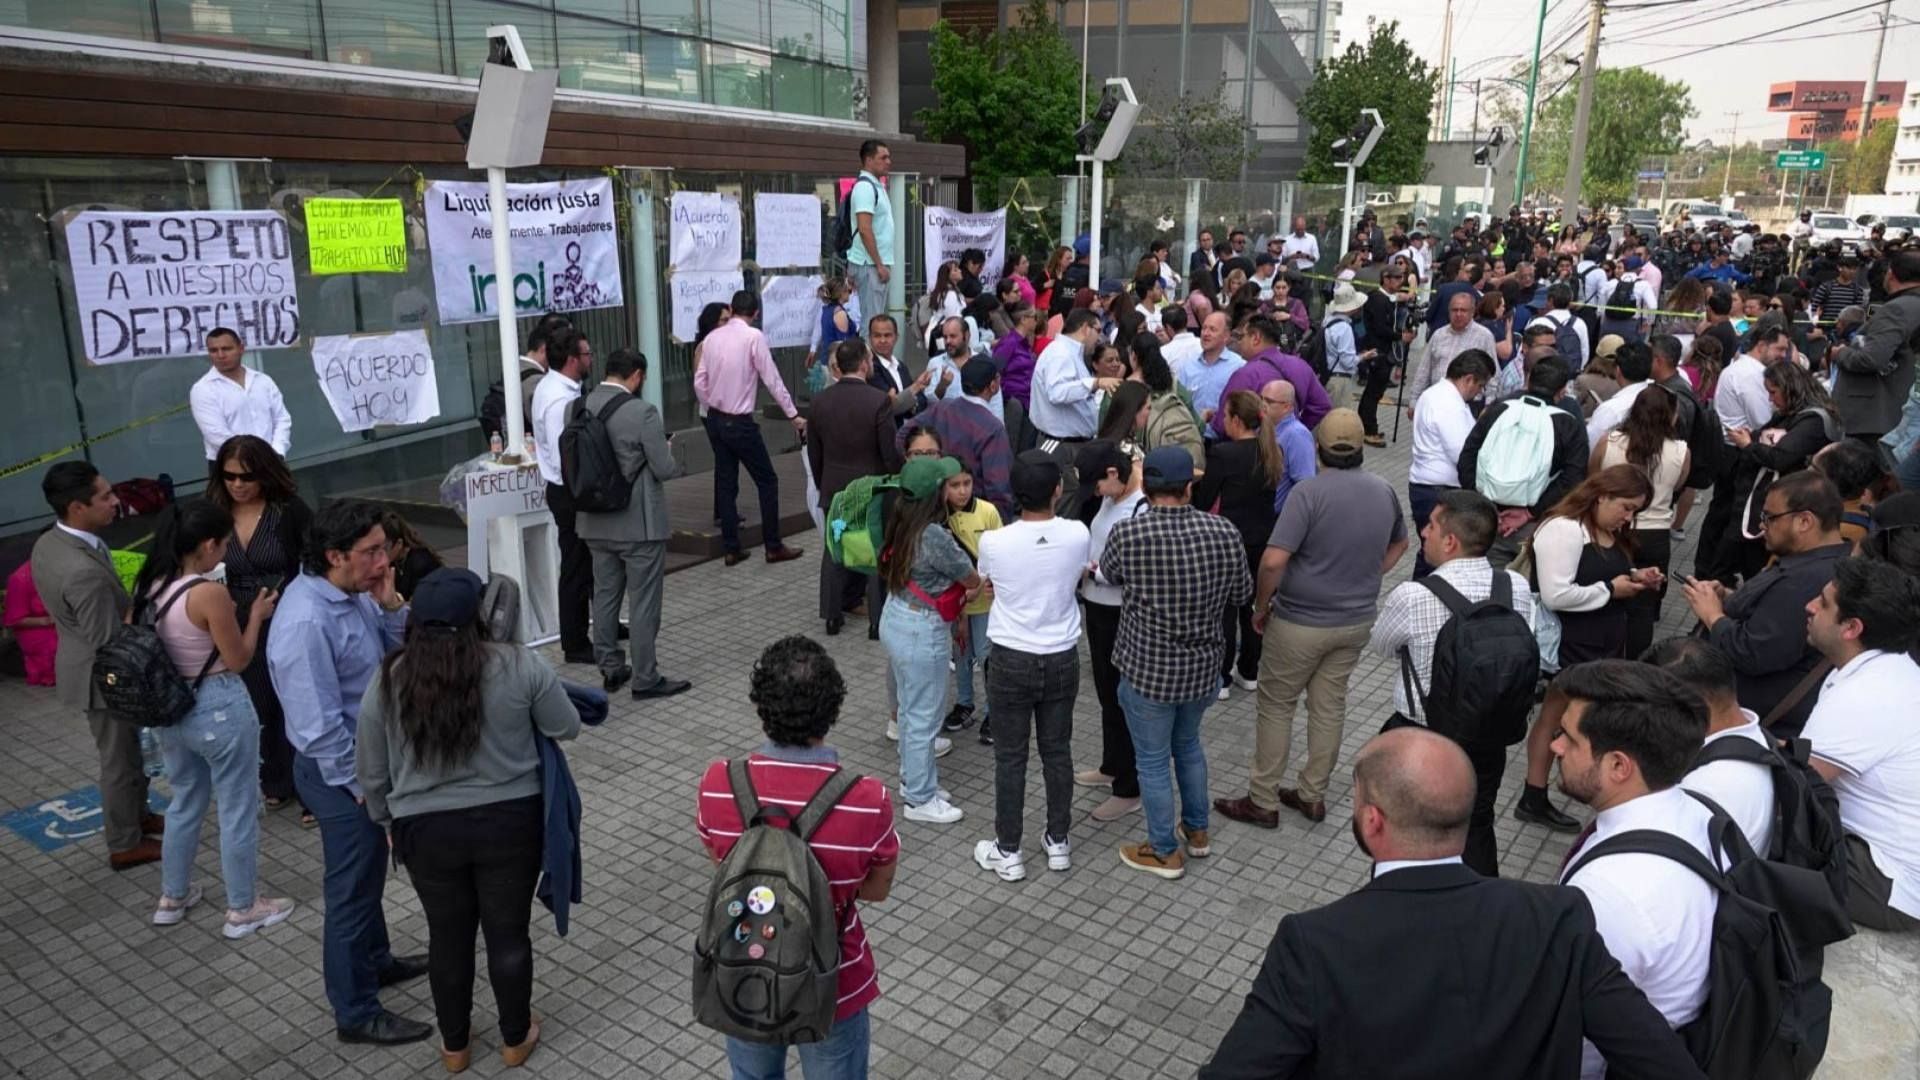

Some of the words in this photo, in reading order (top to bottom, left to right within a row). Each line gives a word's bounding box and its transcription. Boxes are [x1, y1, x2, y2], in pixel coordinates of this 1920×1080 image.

[444, 192, 553, 216] Liquiación
[557, 191, 600, 214] justa
[87, 216, 290, 265] RESPETO
[471, 225, 546, 240] Atemente:
[549, 221, 613, 237] Trabajadores
[384, 244, 406, 266] HOY
[107, 269, 129, 300] A
[144, 261, 285, 298] NUESTROS
[91, 294, 300, 359] DERECHOS
[325, 353, 427, 391] ACUERDO
[351, 390, 410, 424] HOY
[523, 492, 547, 511] TRA
